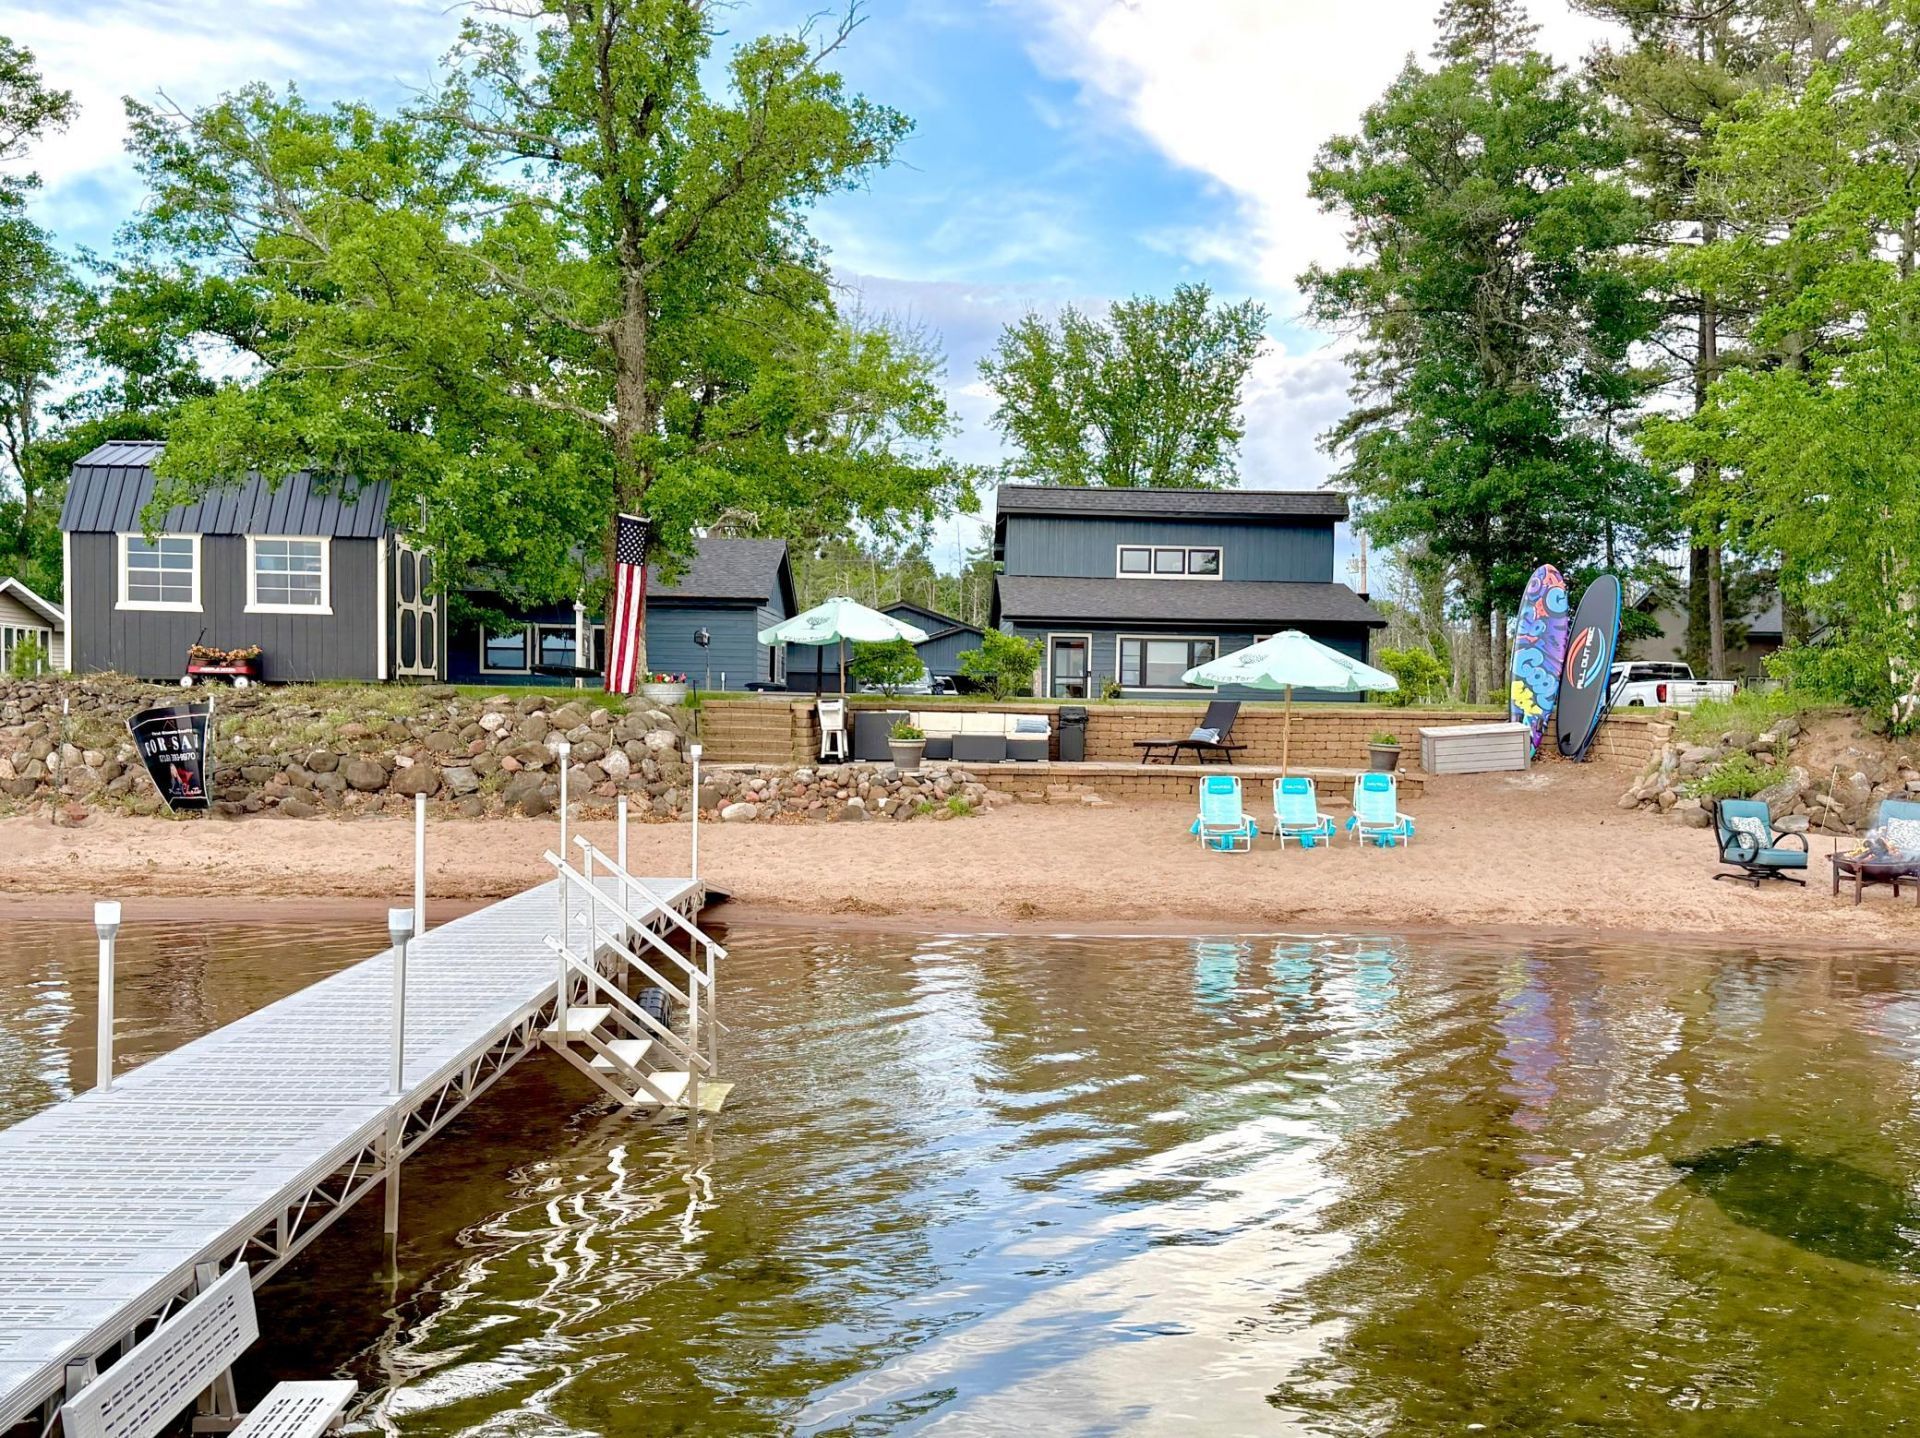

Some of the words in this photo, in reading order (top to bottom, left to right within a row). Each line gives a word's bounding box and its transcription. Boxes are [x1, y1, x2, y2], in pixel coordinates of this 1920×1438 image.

[1581, 648, 1590, 668] OUT
[1577, 669, 1586, 689] ALL
[145, 738, 167, 756] FOR
